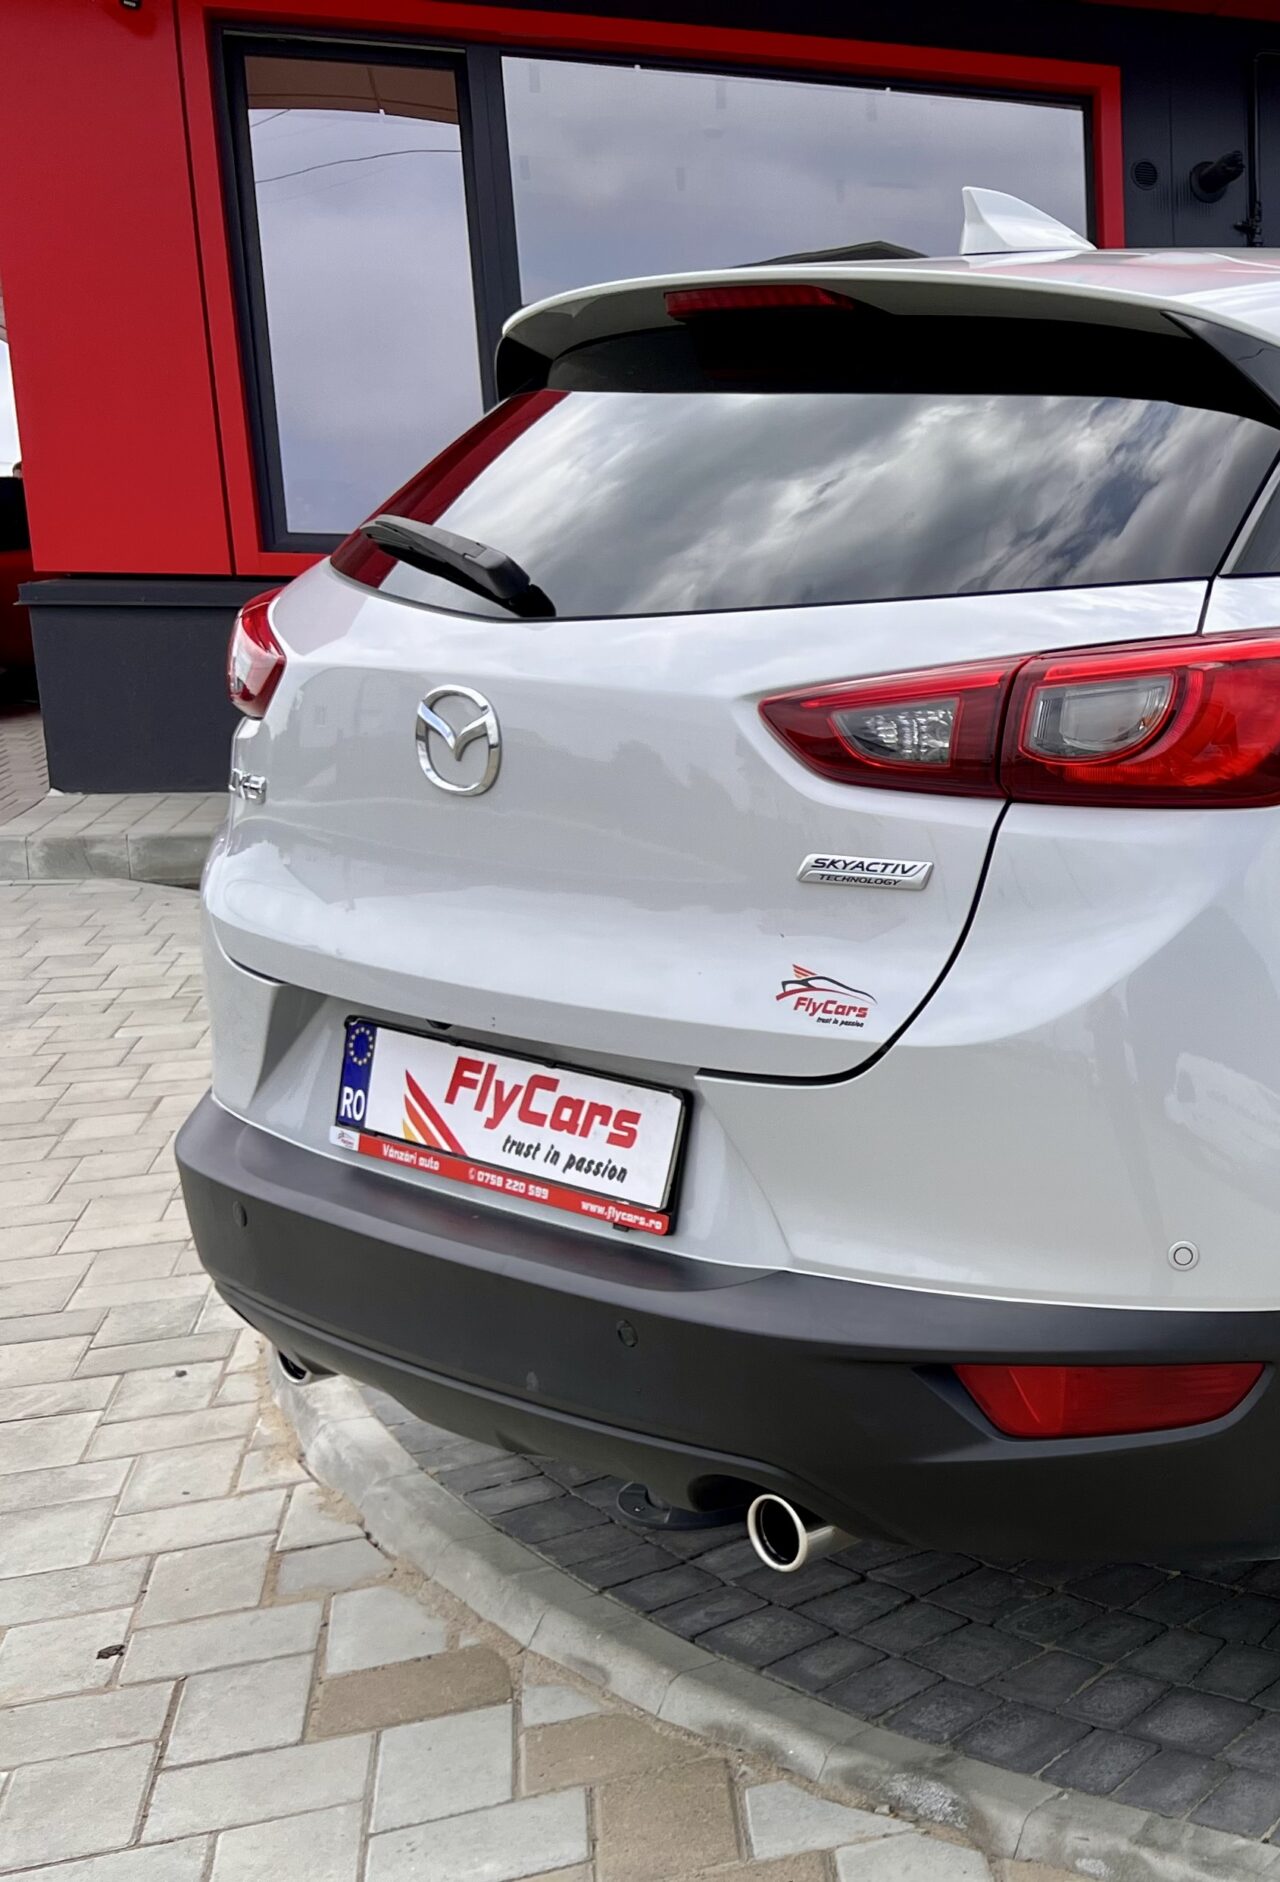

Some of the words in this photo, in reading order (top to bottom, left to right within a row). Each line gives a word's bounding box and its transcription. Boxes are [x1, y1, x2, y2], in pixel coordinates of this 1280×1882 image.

[811, 857, 917, 875] SKYACTIV
[818, 873, 902, 887] TECHNOLOGY
[793, 996, 869, 1019] FlyCars
[340, 1086, 367, 1122] RO
[444, 1055, 642, 1149] FlyCars
[418, 1156, 440, 1171] auto
[502, 1134, 542, 1162] trust
[544, 1148, 560, 1166] in
[562, 1152, 629, 1184] passion
[505, 1178, 526, 1193] 220
[580, 1200, 662, 1230] www.flycars.ro
